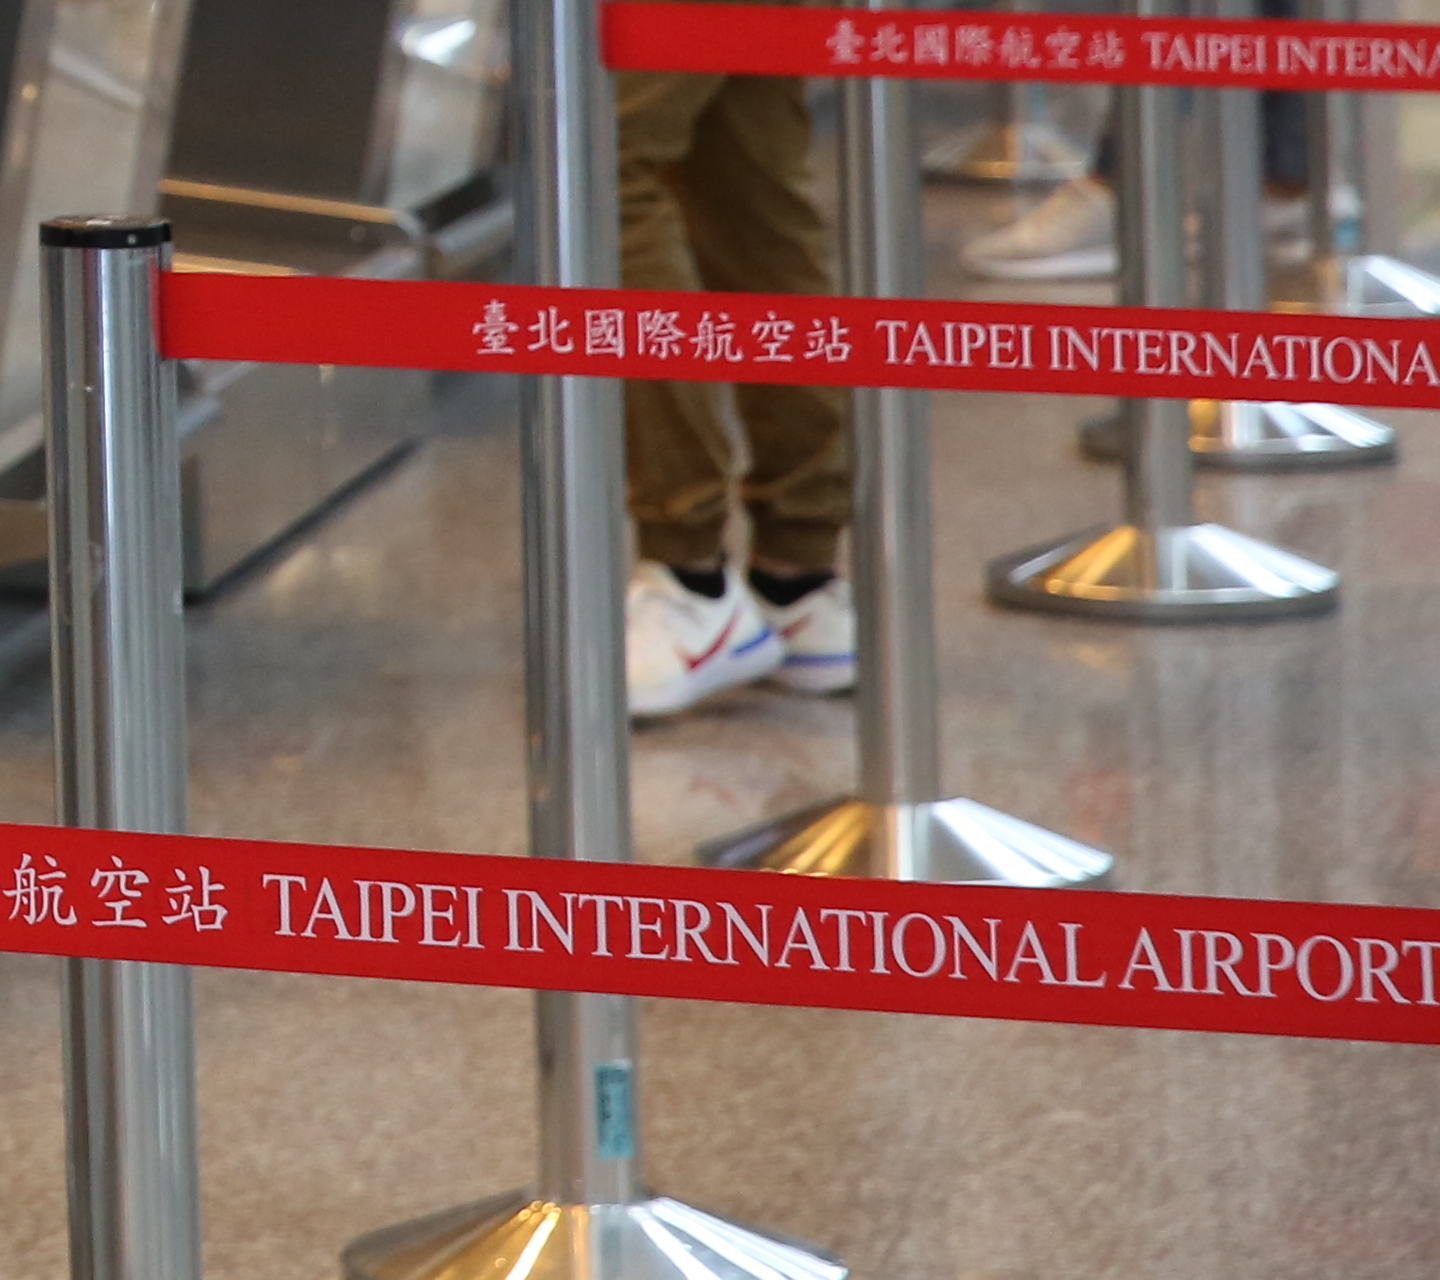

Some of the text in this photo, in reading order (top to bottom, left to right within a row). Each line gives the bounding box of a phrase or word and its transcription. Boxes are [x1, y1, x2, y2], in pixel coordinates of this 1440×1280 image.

[1142, 31, 1266, 75] TAIPEI
[471, 299, 1440, 388] 臺北國際航空站 TAIPEI INTERNATIONA
[261, 871, 485, 951] TAIPEI
[501, 887, 1108, 991] INTERNATIONAL
[1117, 925, 1440, 1008] AIRPORT
